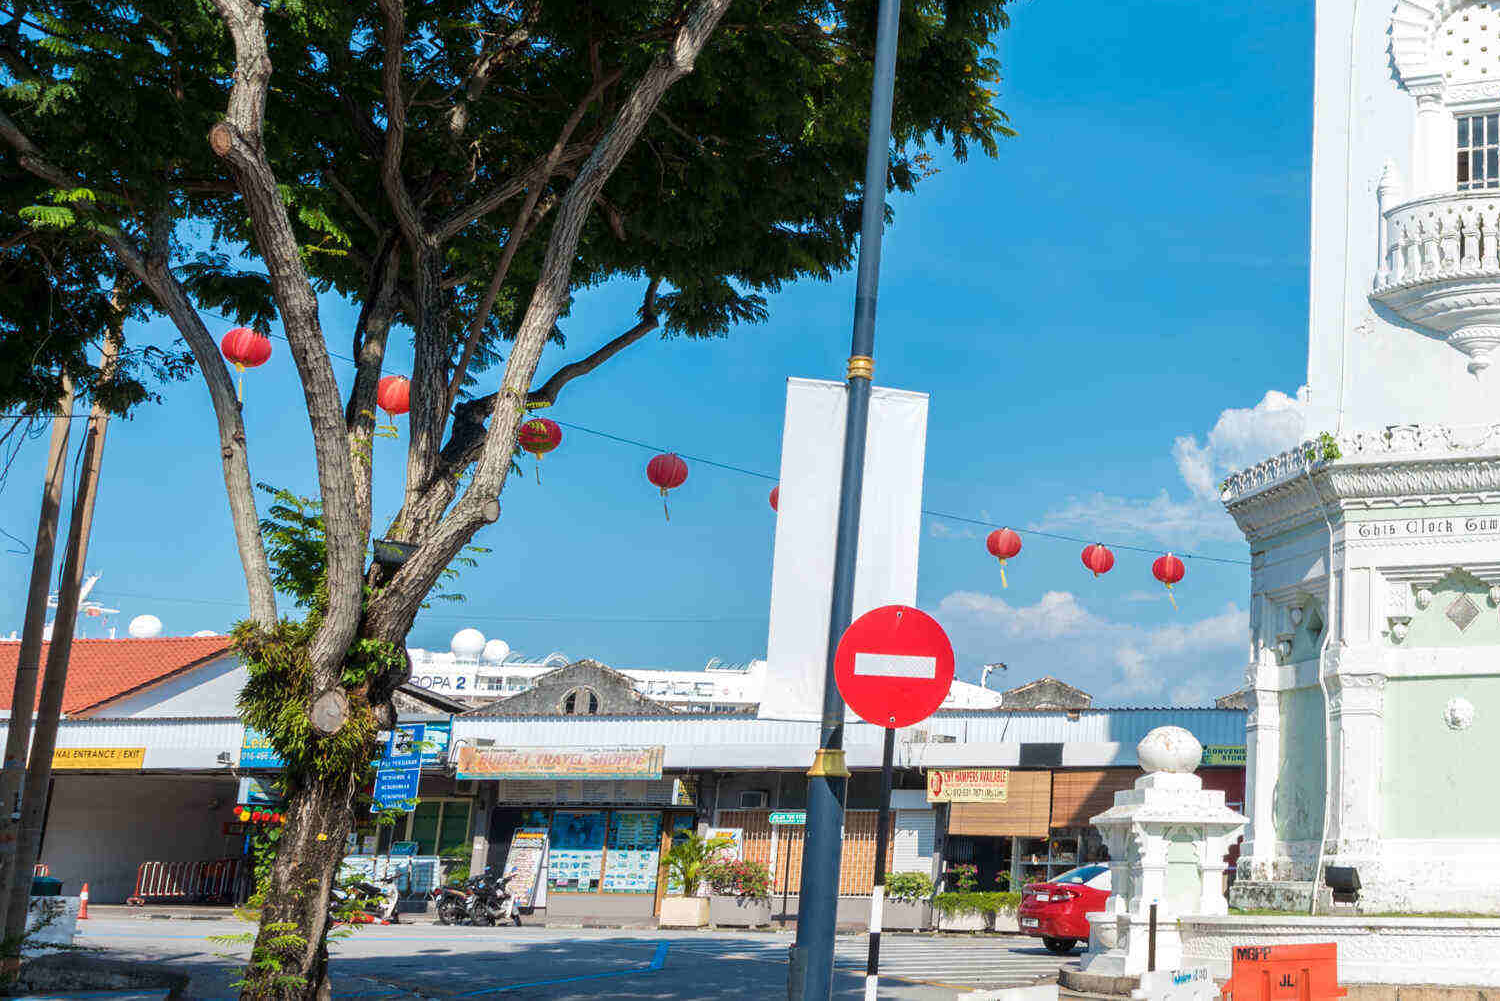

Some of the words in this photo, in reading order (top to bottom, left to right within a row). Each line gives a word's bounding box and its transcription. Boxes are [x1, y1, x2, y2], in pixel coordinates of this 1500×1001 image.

[1406, 518, 1453, 534] Clock
[455, 676, 467, 690] 2
[73, 749, 115, 759] ENTRANCE
[123, 749, 140, 759] EXIT
[480, 753, 529, 767] BUDGET
[536, 754, 584, 767] TRAVEL
[589, 753, 643, 767] SHOPPE
[980, 771, 1006, 783] AVAILABLE
